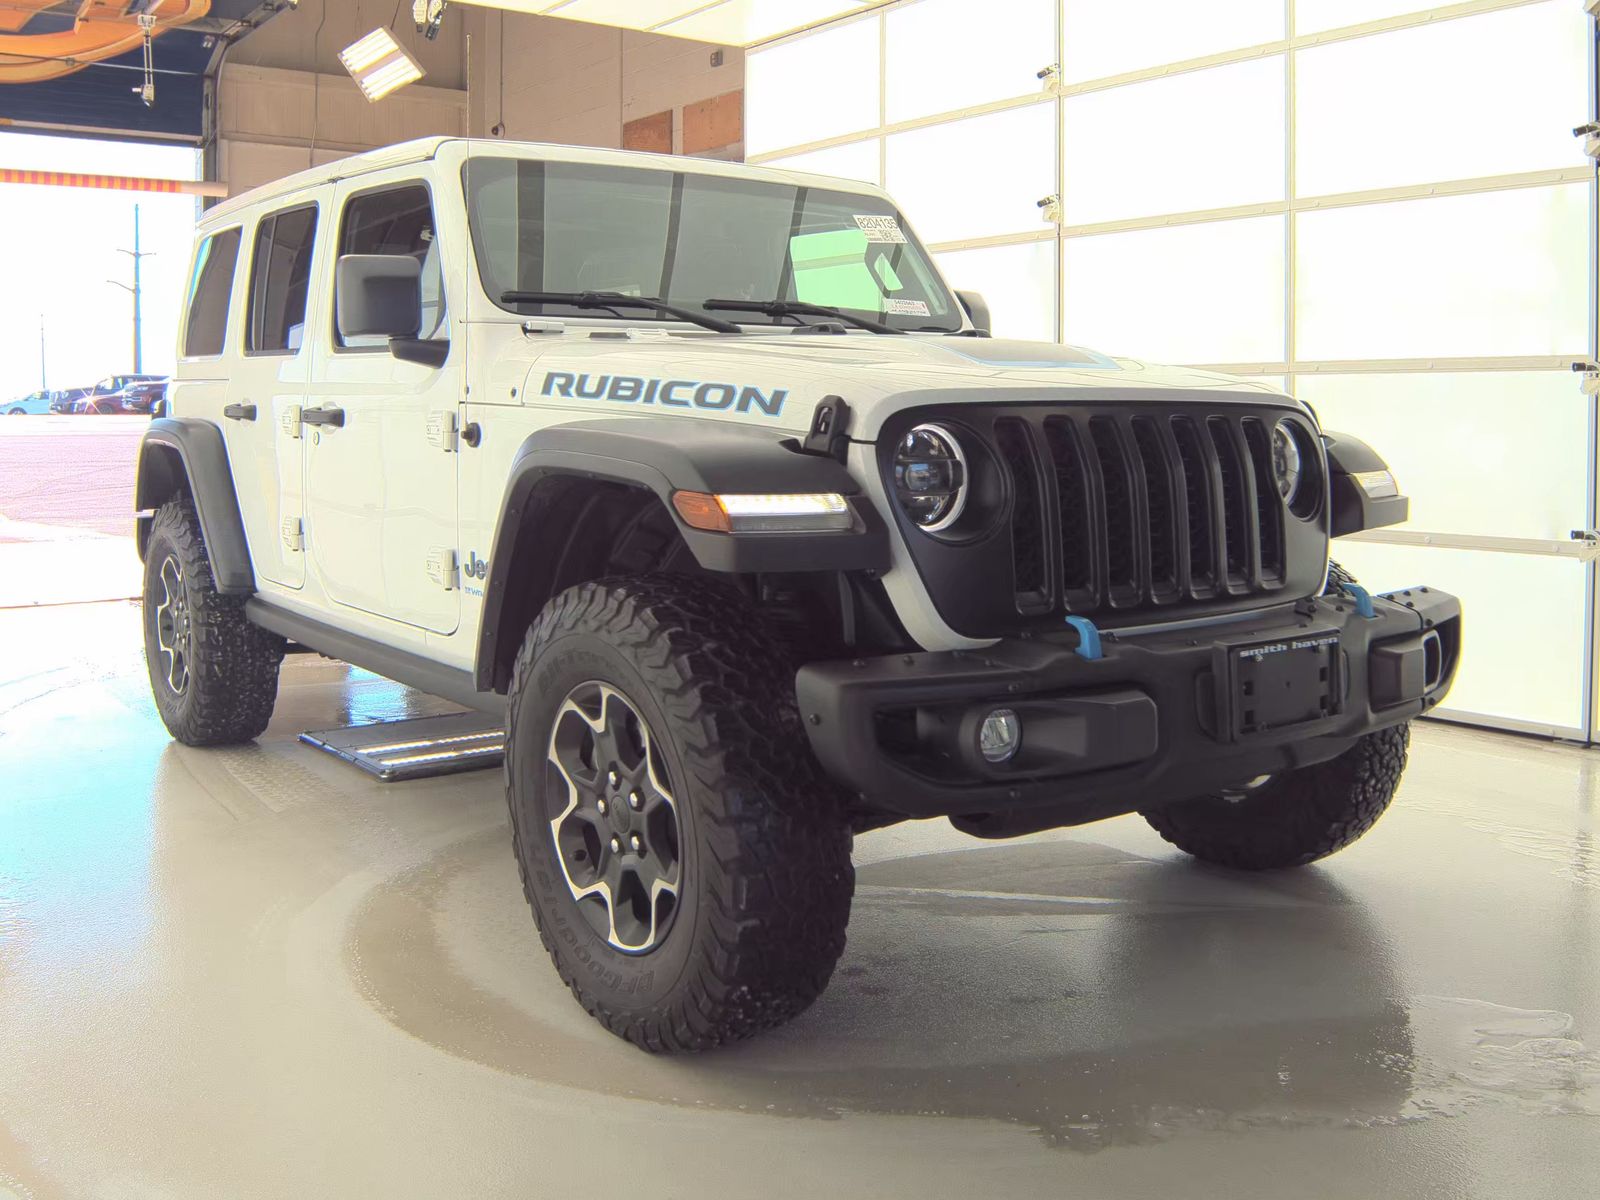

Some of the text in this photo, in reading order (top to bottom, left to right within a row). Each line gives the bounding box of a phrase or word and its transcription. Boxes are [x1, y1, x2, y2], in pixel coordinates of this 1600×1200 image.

[857, 217, 898, 229] 8204135
[541, 372, 789, 417] RUBICON
[464, 551, 489, 580] Je
[1239, 637, 1338, 658] smith haven
